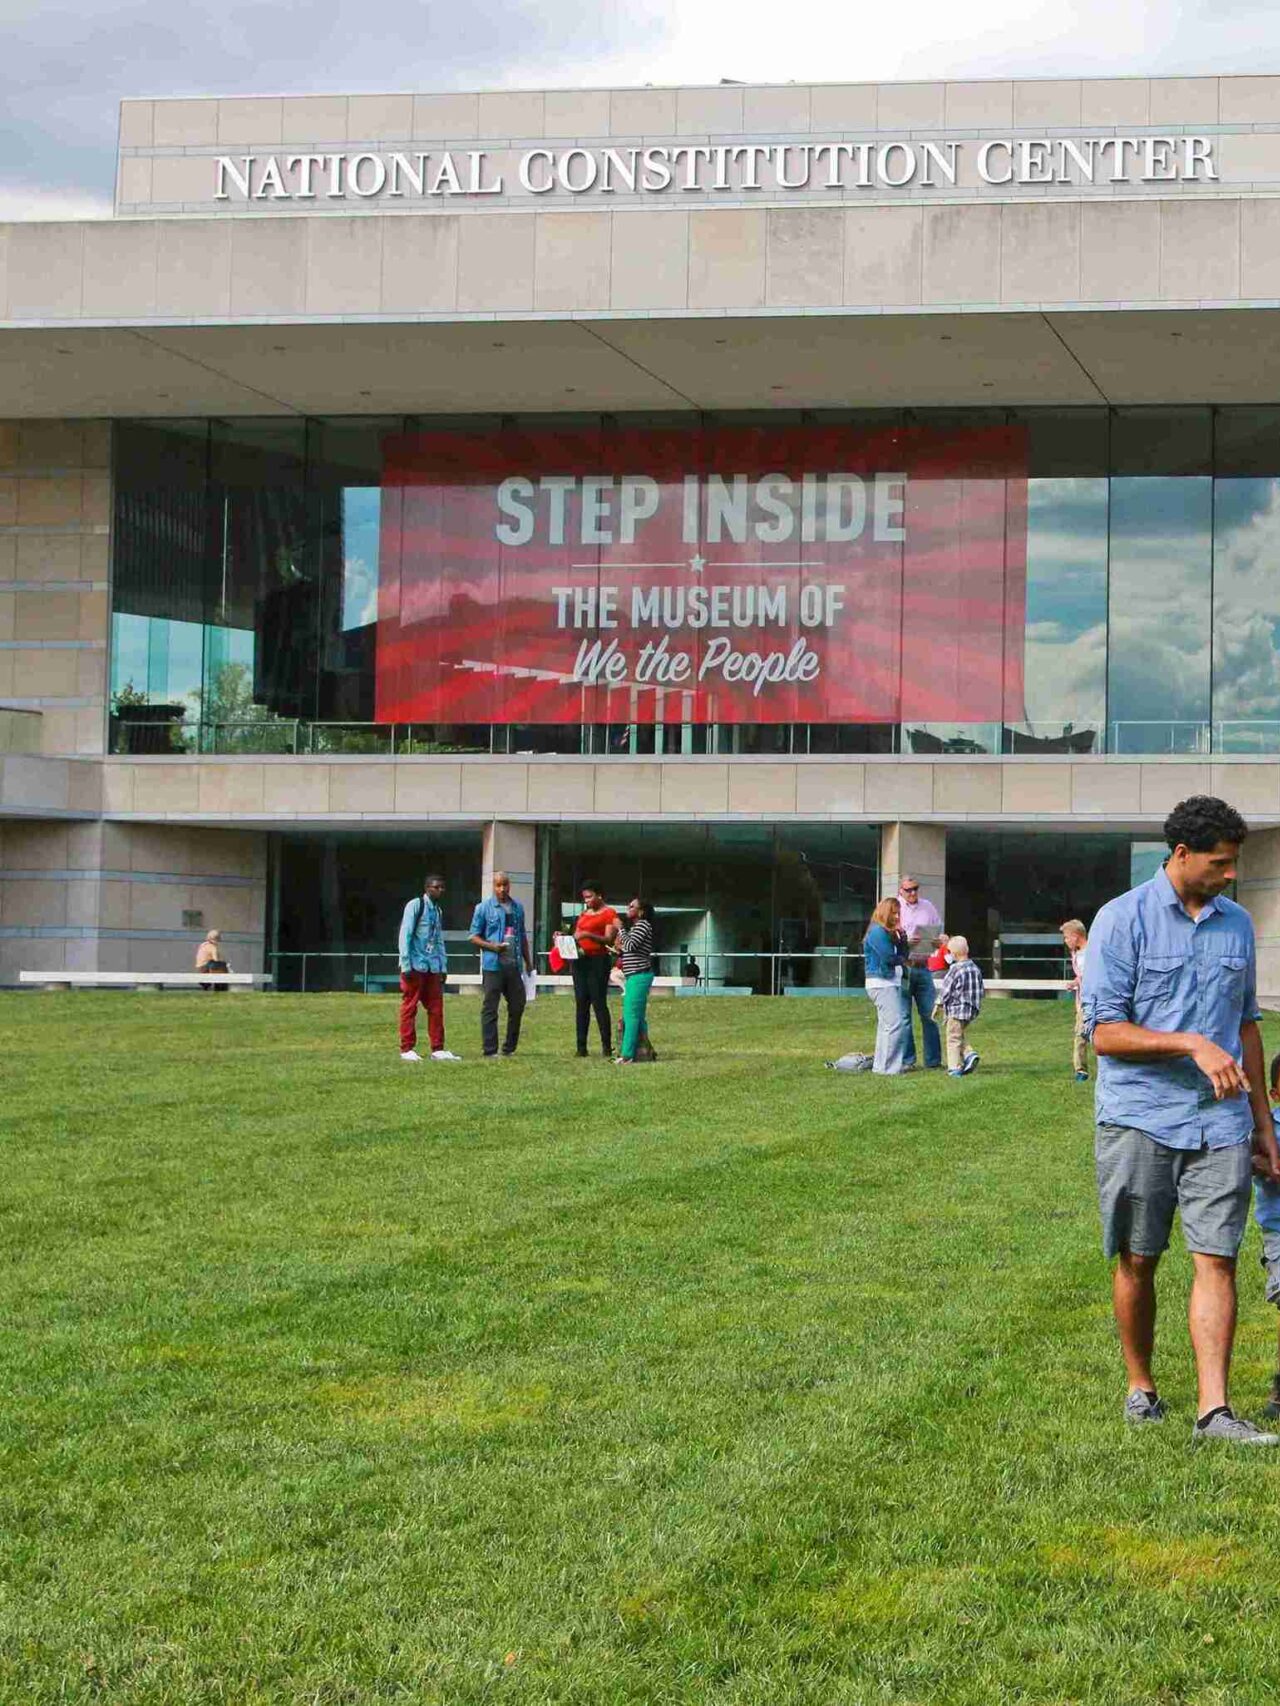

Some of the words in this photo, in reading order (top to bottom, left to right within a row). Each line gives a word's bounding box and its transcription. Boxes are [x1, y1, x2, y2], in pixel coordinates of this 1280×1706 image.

[212, 151, 503, 200] NATIONAL
[518, 141, 961, 195] CONSTITUTION
[976, 136, 1219, 185] CENTER
[495, 475, 660, 547] STEP
[682, 472, 908, 544] INSIDE
[551, 587, 619, 629] THE
[631, 585, 787, 629] MUSEUM
[800, 584, 846, 628] OF
[572, 637, 629, 683] We
[634, 635, 692, 683] the
[697, 636, 821, 698] People
